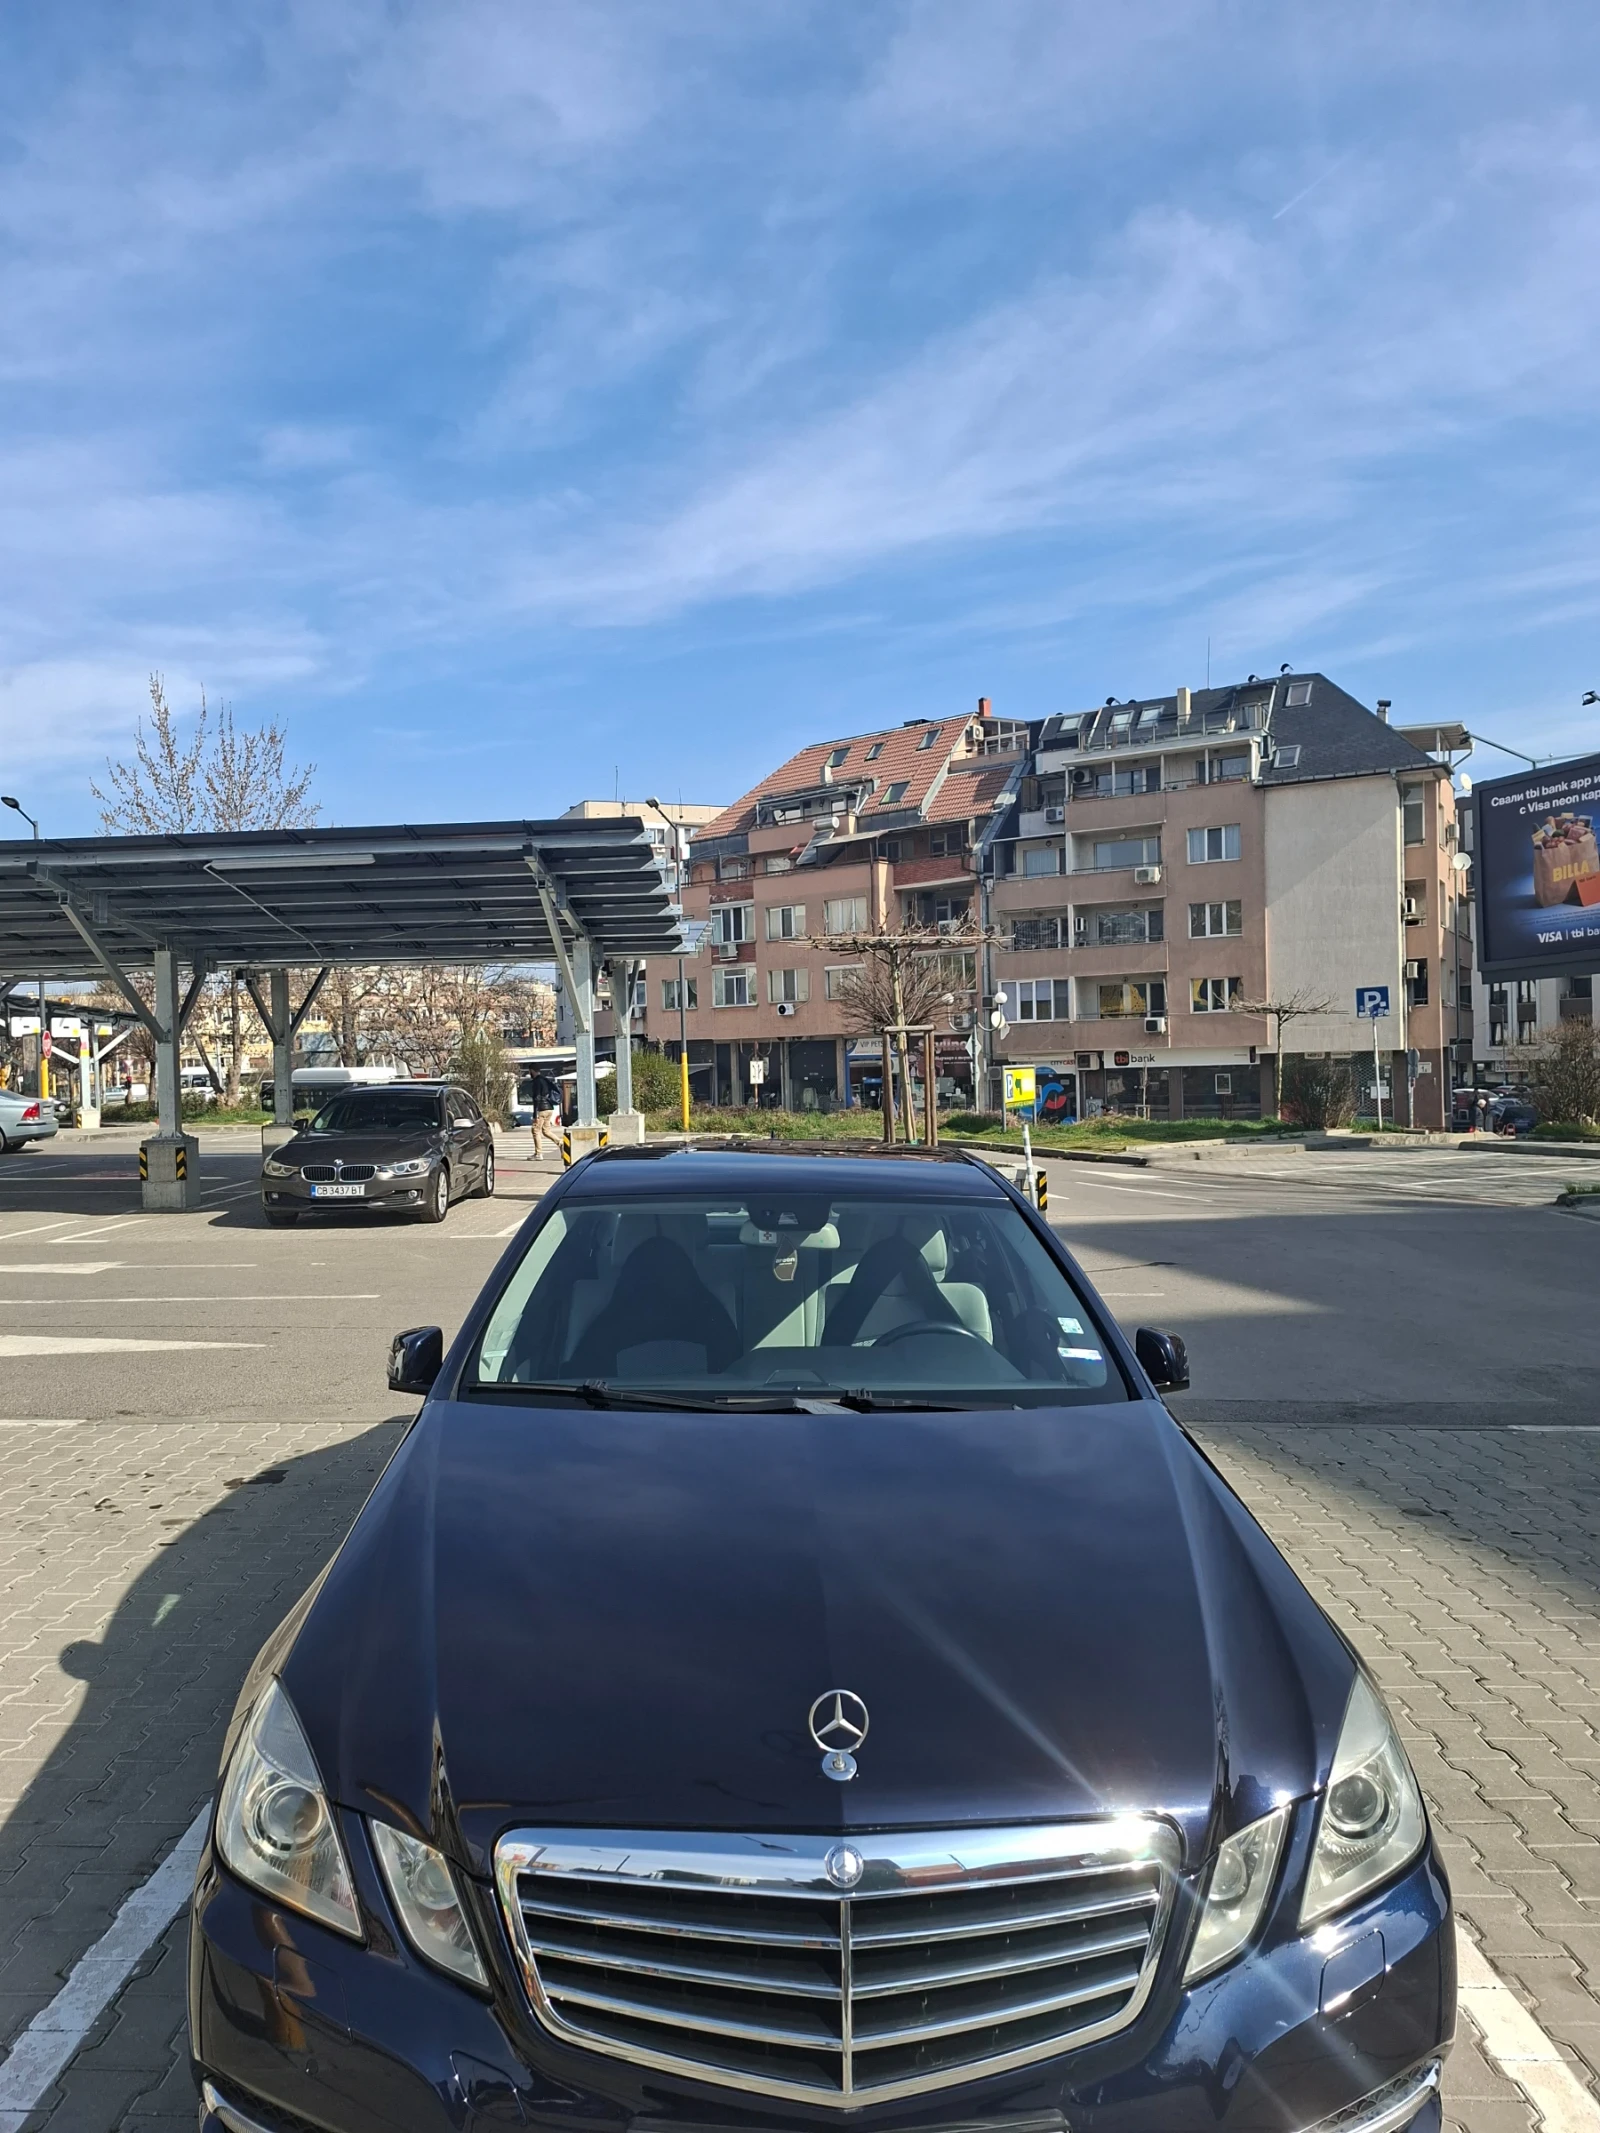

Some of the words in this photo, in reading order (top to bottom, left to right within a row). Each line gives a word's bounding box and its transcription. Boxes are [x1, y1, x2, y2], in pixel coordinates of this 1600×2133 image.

[1491, 793, 1524, 807] Свали
[1526, 787, 1540, 799] tbi
[1542, 781, 1568, 795] bank
[1570, 777, 1592, 790] app
[1527, 801, 1550, 813] Visa
[1552, 794, 1579, 808] neon
[1553, 860, 1590, 882] BILLA
[1536, 931, 1563, 943] VISA
[1571, 928, 1584, 938] tbi
[1587, 927, 1600, 937] ba
[1115, 1053, 1128, 1064] tbi
[1131, 1053, 1155, 1063] bank
[316, 1186, 328, 1195] CB
[330, 1186, 350, 1195] 3437
[351, 1186, 362, 1195] BT
